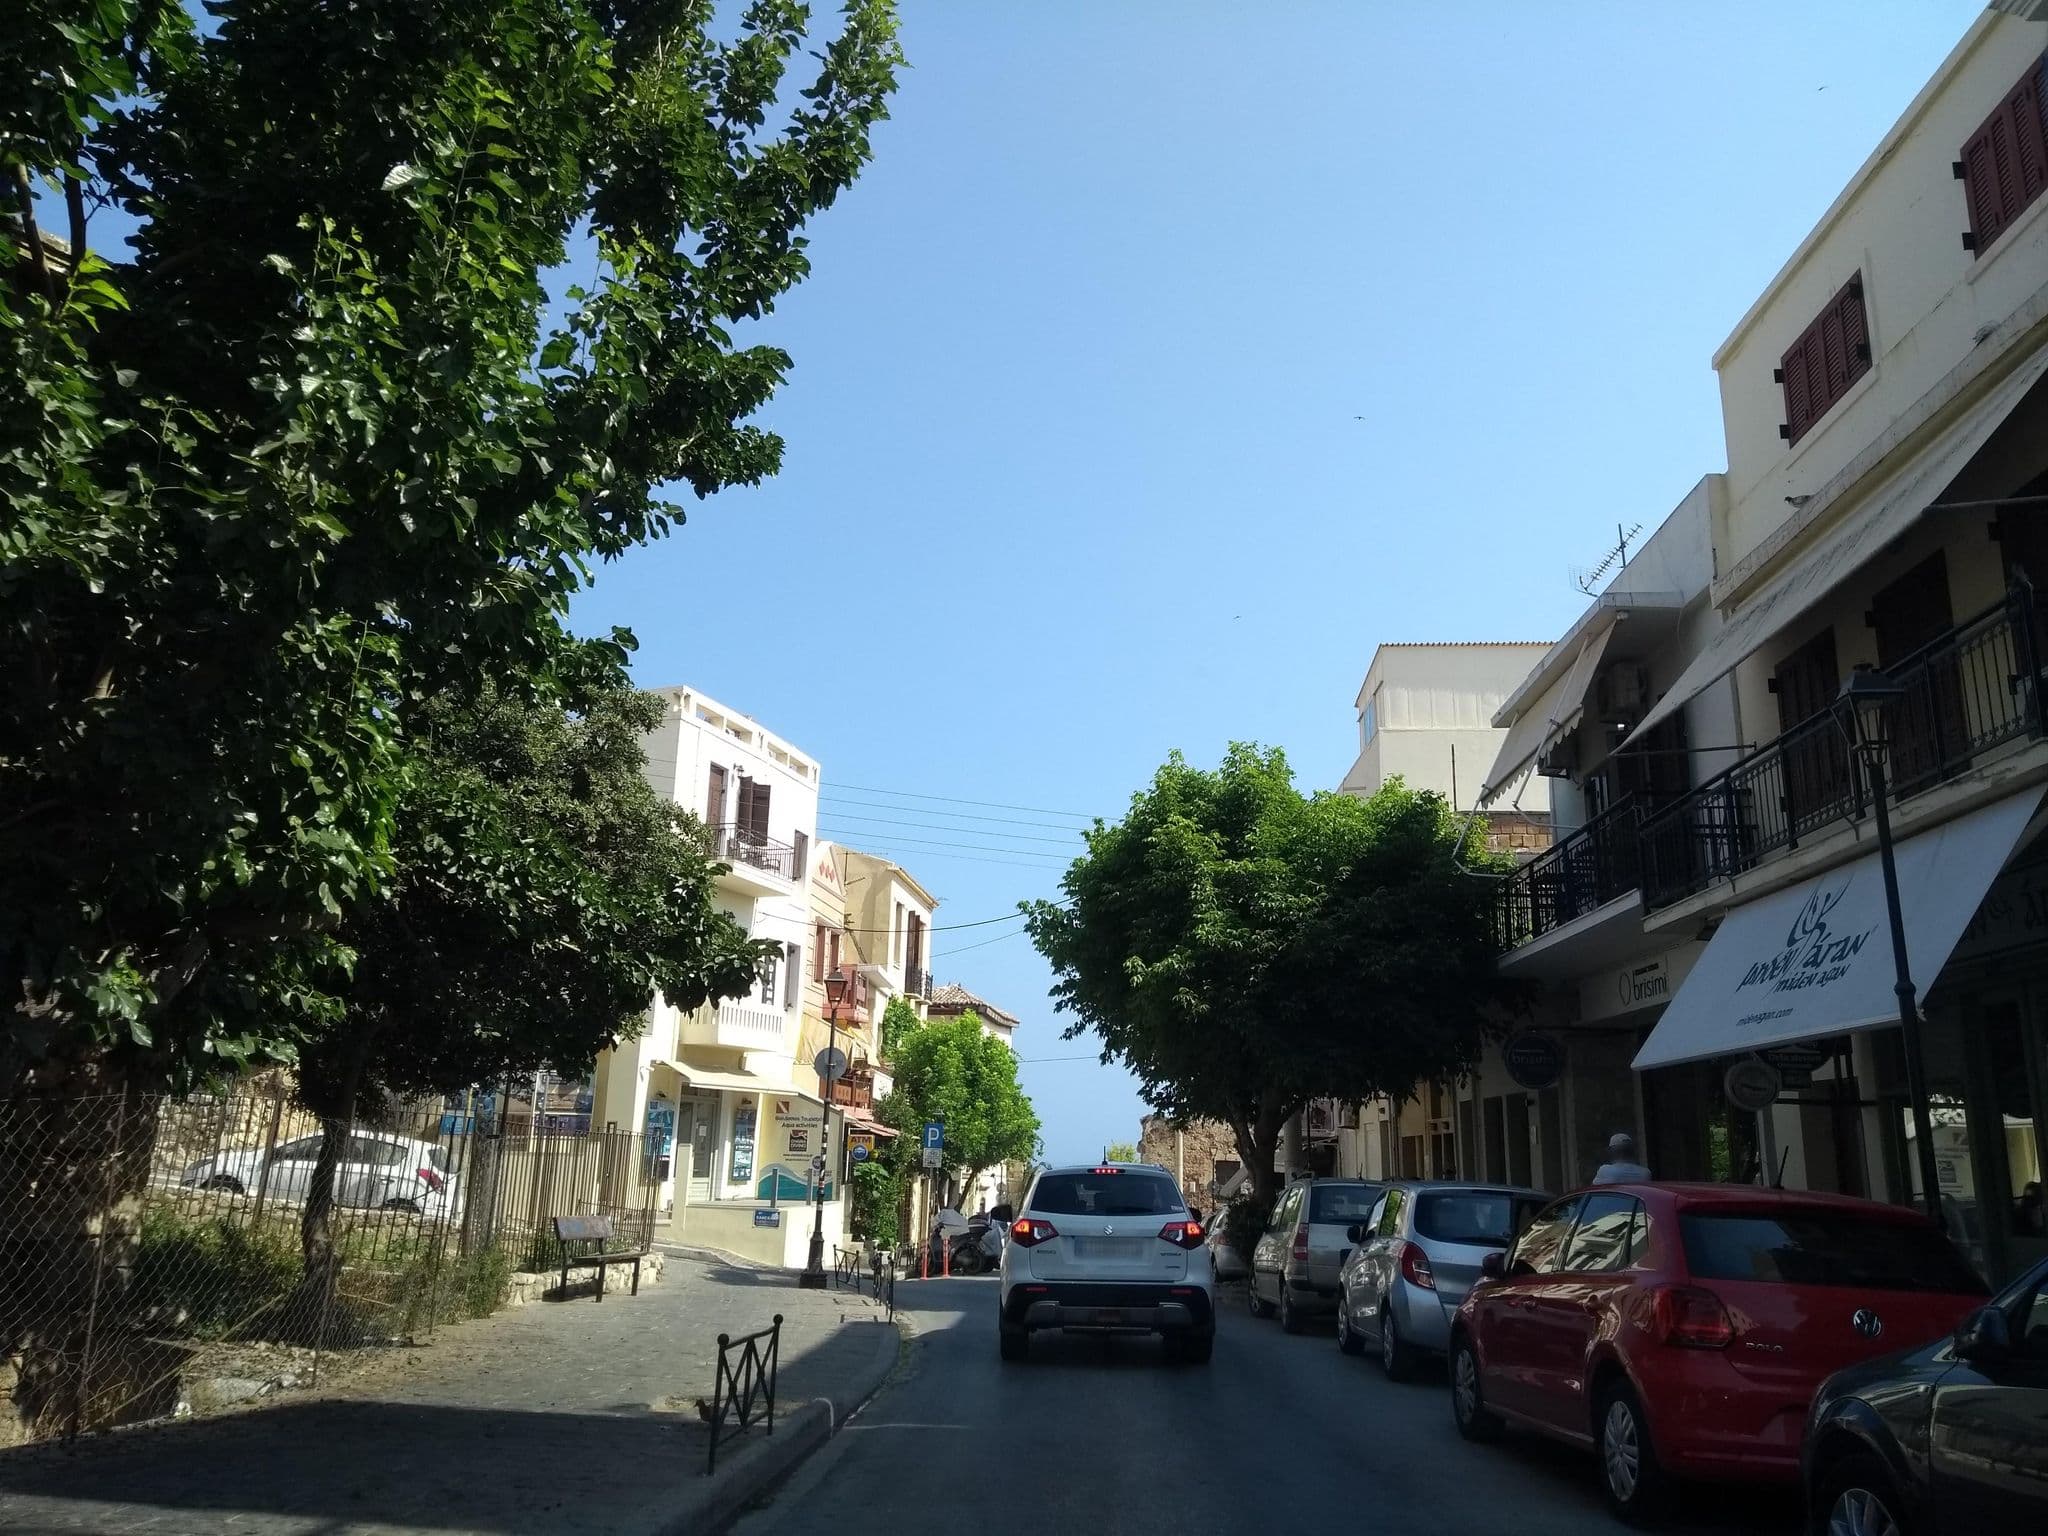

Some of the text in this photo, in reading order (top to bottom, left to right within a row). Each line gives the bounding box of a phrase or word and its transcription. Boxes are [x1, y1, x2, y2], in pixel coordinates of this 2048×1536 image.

[1632, 970, 1667, 1000] brisimi
[850, 1136, 871, 1144] ATM
[928, 1127, 940, 1148] P
[1745, 1342, 1784, 1353] POLO
